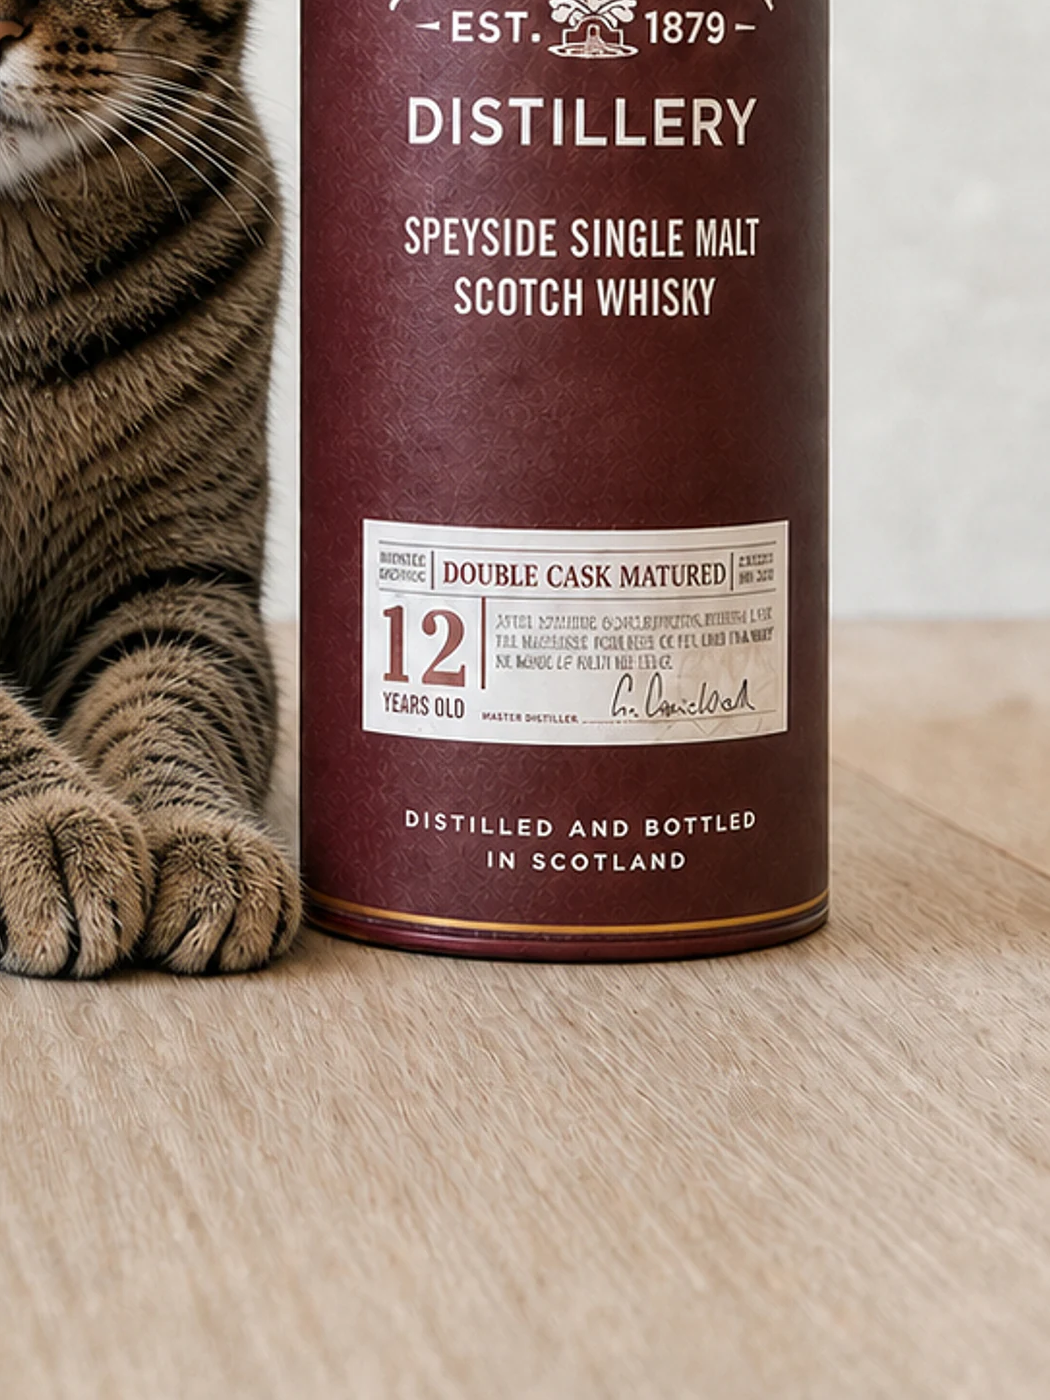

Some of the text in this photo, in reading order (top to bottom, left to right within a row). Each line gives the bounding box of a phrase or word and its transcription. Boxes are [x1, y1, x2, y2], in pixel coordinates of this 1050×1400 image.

[451, 10, 725, 44] EST. 1879
[408, 96, 757, 146] DISTILLERY
[404, 216, 760, 258] SPEYSIDE SINGLE MALT
[453, 276, 716, 317] SCOTCH WHISKY
[443, 561, 538, 587] DOUBLE
[546, 564, 612, 589] CASK
[620, 562, 727, 588] MATURED
[382, 605, 466, 688] 12
[382, 691, 465, 719] YEARS OLD
[405, 809, 756, 837] DISTILLED AND BOTTLED
[487, 850, 685, 872] IN SCOTLAND
